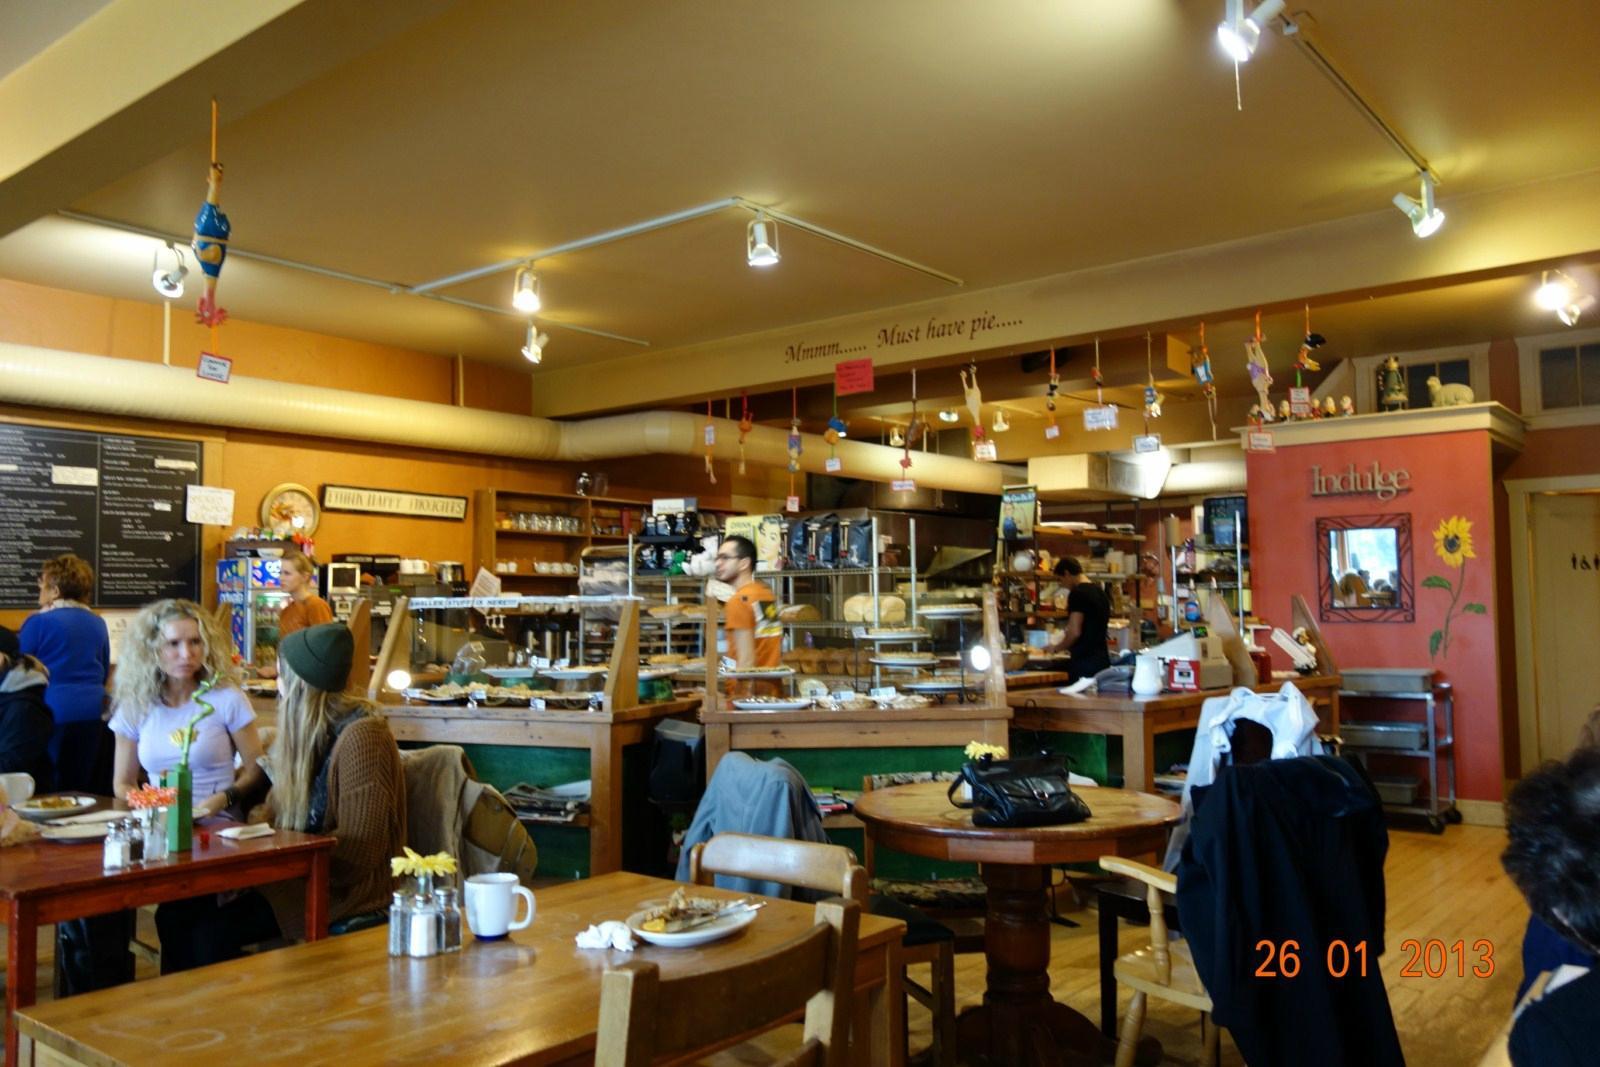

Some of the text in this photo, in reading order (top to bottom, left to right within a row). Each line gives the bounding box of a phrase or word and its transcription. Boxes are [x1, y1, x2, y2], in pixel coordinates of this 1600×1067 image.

[877, 323, 920, 348] Must
[926, 317, 965, 340] have
[1311, 460, 1411, 501] Indulge
